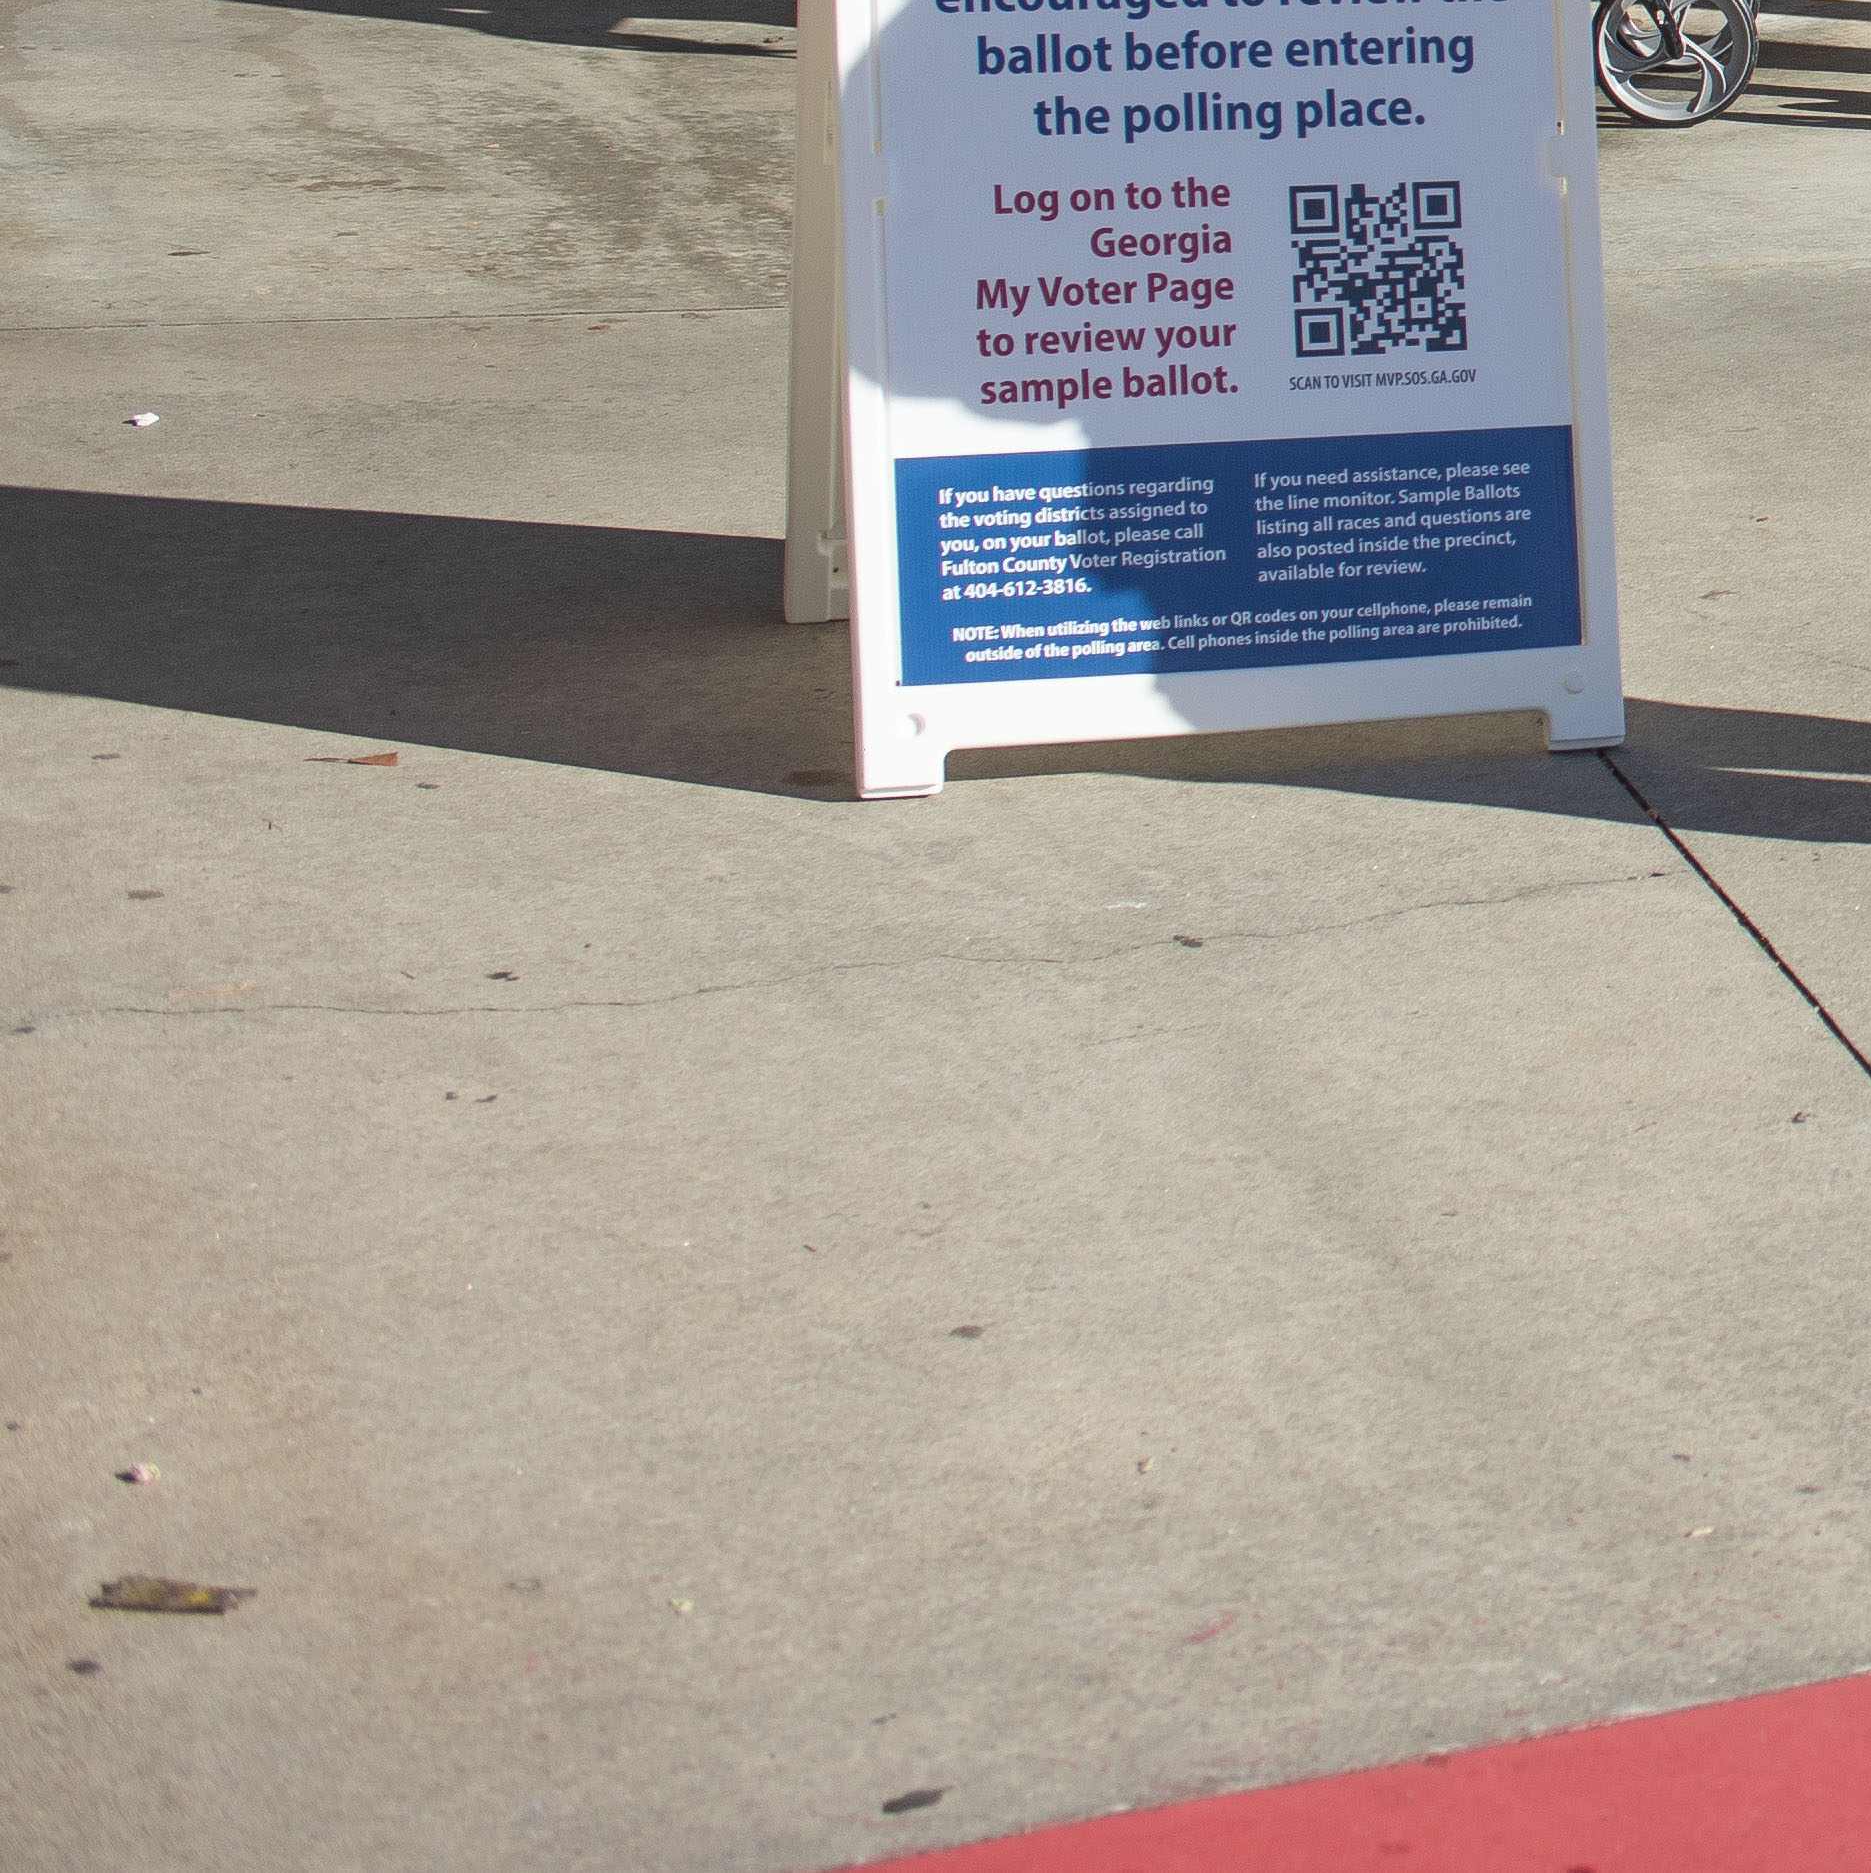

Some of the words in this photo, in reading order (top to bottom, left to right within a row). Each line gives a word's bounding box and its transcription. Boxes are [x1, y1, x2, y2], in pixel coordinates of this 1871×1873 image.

[977, 33, 1112, 75] ballot
[1124, 29, 1273, 72] before
[1285, 26, 1474, 73] entering
[1033, 95, 1110, 137] the
[1123, 92, 1282, 144] polling
[1295, 88, 1425, 138] place.
[993, 183, 1059, 221] Log
[1070, 184, 1115, 212] on
[1125, 181, 1162, 210] to
[1171, 176, 1230, 207] the
[1089, 224, 1232, 263] Georgia
[975, 278, 1030, 317] My
[1038, 276, 1137, 307] Voter
[1146, 272, 1234, 310] Page
[976, 328, 1014, 357] to
[1025, 321, 1145, 355] review
[1155, 321, 1237, 358] your
[980, 368, 1112, 409] sample
[1122, 364, 1239, 399] ballot.
[1289, 376, 1321, 391] SCAN
[1324, 375, 1339, 389] TO
[1341, 373, 1372, 388] VISIT
[1375, 369, 1477, 387] MVP.SOS.GA.GOV
[1254, 472, 1266, 488] If
[1270, 474, 1302, 491] you
[1306, 468, 1348, 486] need
[1352, 466, 1441, 483] assistance,
[1445, 462, 1499, 481] please
[1502, 462, 1530, 476] see
[938, 488, 953, 505] If
[955, 490, 989, 508] you
[992, 486, 1035, 503] have
[1038, 481, 1125, 506] questions
[1128, 477, 1214, 496] regarding
[1255, 496, 1284, 511] the
[1288, 494, 1320, 509] line
[1323, 491, 1395, 508] monitor.
[1398, 486, 1460, 506] Sample
[1465, 484, 1520, 501] Ballots
[939, 511, 970, 528] the
[973, 508, 1031, 529] voting
[1034, 504, 1105, 524] districts
[1108, 500, 1185, 521] assigned
[1189, 502, 1208, 516] to
[1256, 519, 1309, 536] listing
[1313, 516, 1333, 532] all
[1337, 516, 1380, 531] races
[1384, 511, 1416, 527] and
[1420, 509, 1501, 529] questions
[1505, 508, 1532, 521] are
[940, 537, 979, 556] you,
[982, 537, 1006, 551] on
[1010, 535, 1051, 553] your
[1054, 528, 1110, 547] ballot,
[1114, 525, 1170, 546] please
[1174, 523, 1203, 540] call
[1257, 542, 1292, 559] also
[1296, 538, 1354, 560] posted
[1358, 535, 1409, 553] inside
[1412, 533, 1441, 549] the
[1444, 529, 1516, 551] precinct,
[941, 558, 999, 576] Fulton
[1002, 556, 1067, 574] County
[1069, 553, 1117, 569] Voter
[1121, 546, 1226, 568] Registration
[1258, 563, 1334, 583] available
[1338, 561, 1362, 577] for
[1366, 560, 1427, 576] review.
[942, 585, 961, 601] at
[963, 577, 1092, 598] 404-612-3816.
[952, 626, 999, 642] NOTE:
[1000, 624, 1045, 639] When
[1047, 620, 1109, 638] utilizing
[1111, 618, 1137, 632] the
[1140, 614, 1170, 631] web
[1174, 613, 1208, 628] links
[1212, 614, 1227, 626] or
[1231, 612, 1252, 626] QR
[1254, 610, 1296, 624] codes
[1299, 609, 1318, 621] on
[1321, 607, 1354, 623] your
[1357, 603, 1431, 619] cellphone,
[1434, 598, 1480, 616] please
[1482, 594, 1532, 609] remain
[965, 647, 1022, 663] outside
[1025, 643, 1042, 659] of
[1043, 643, 1069, 657] the
[1071, 639, 1126, 659] polling
[1127, 640, 1164, 653] area.
